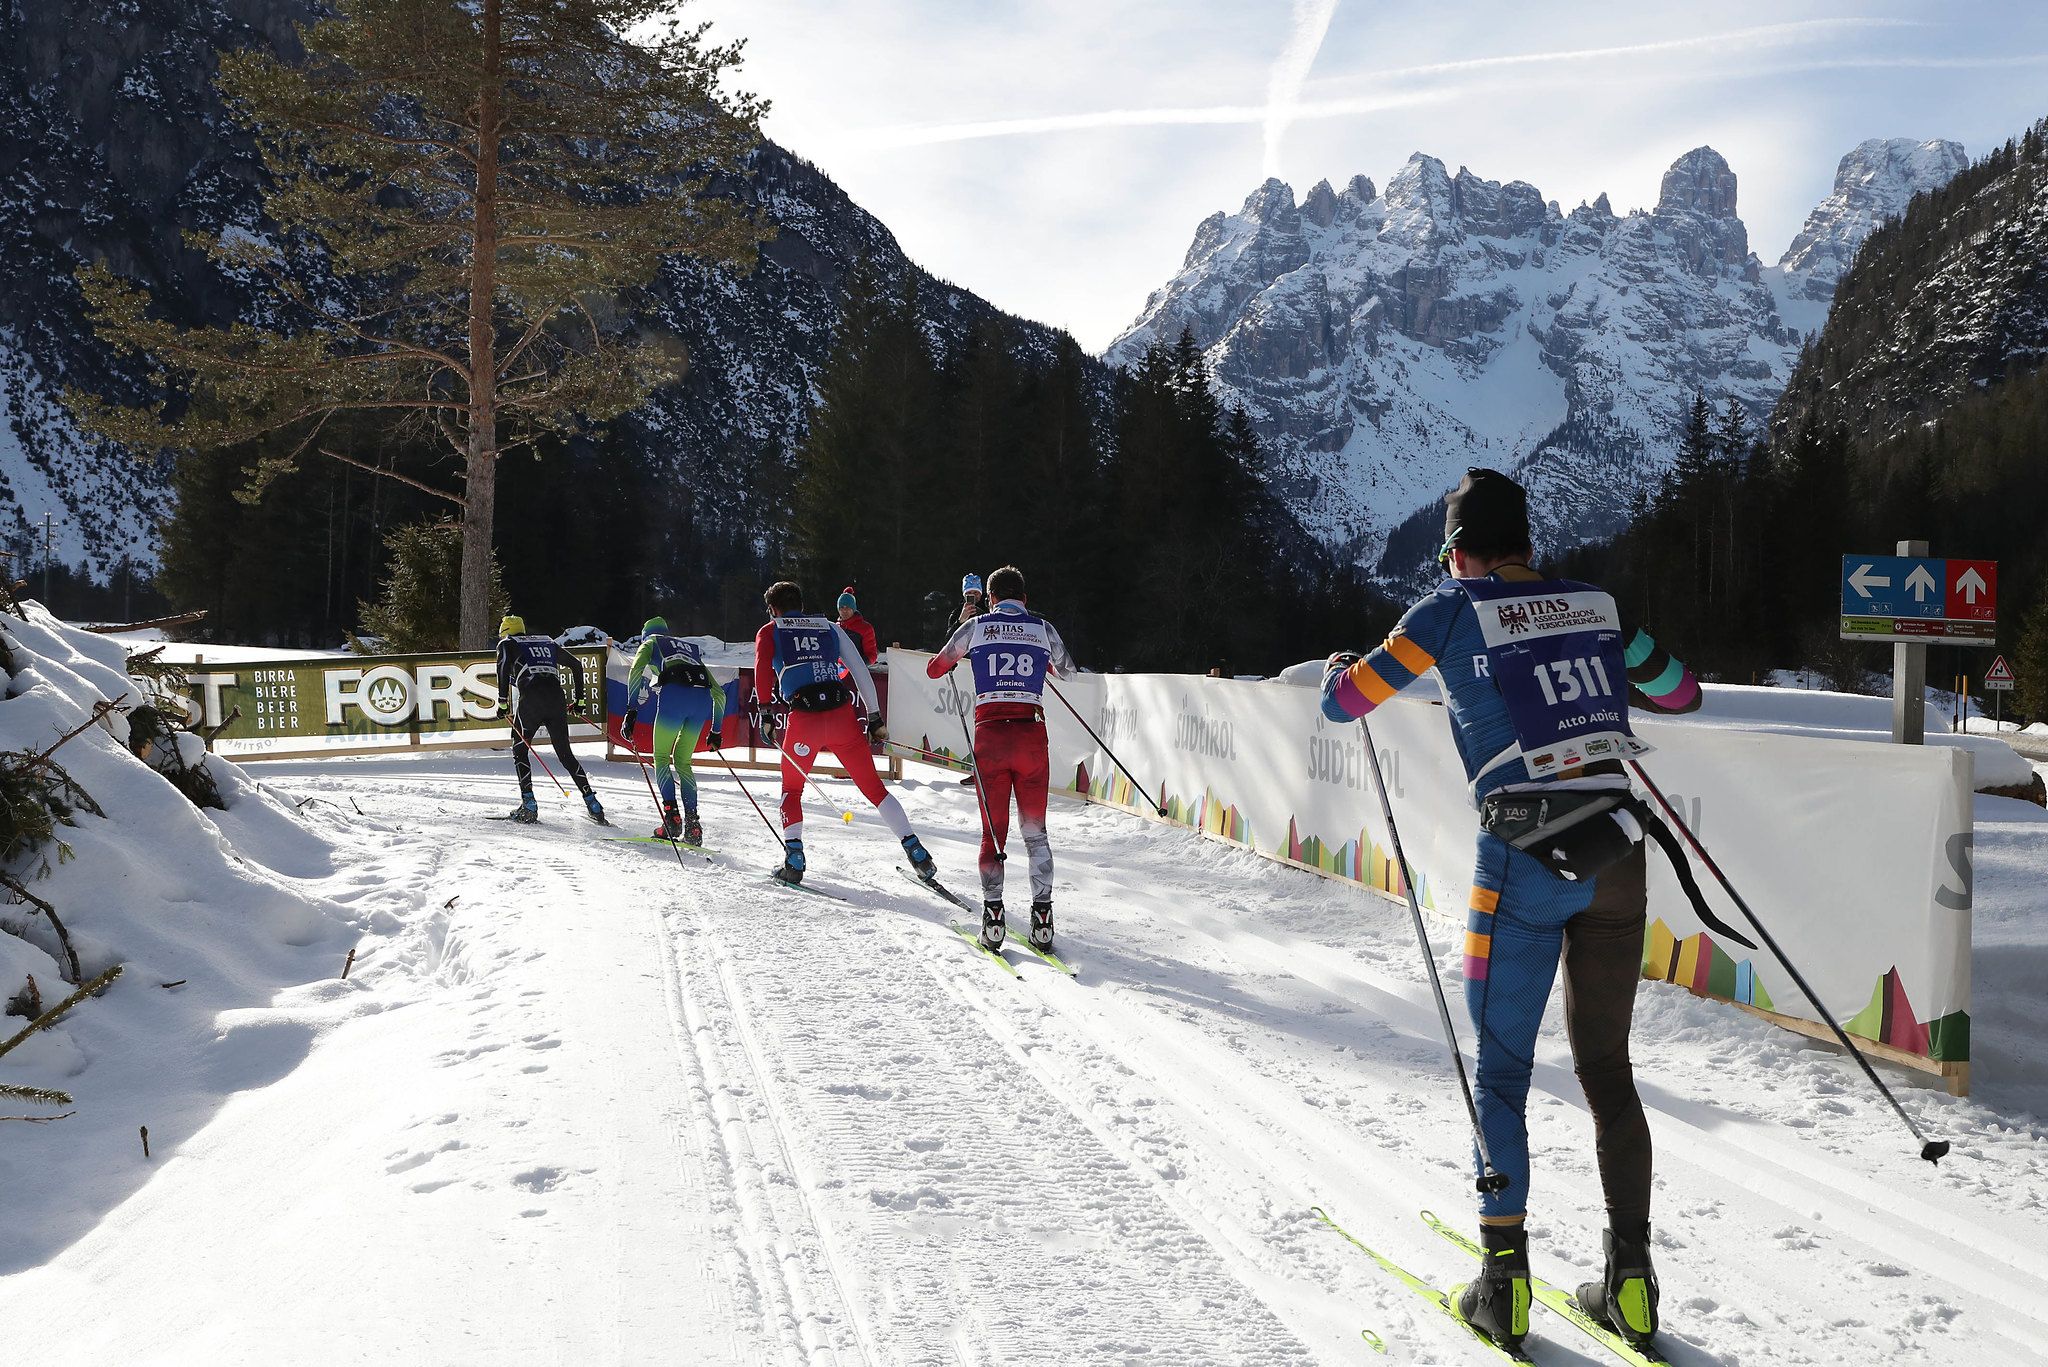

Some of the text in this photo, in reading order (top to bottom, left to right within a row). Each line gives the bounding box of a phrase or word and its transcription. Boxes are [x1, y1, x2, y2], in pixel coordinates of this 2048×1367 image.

[1526, 599, 1570, 616] ITAS
[1533, 608, 1596, 623] ASSICURAZIONI
[1535, 615, 1607, 631] VERSICHERUNGEN
[1002, 624, 1024, 633] ITAS
[793, 636, 820, 651] 145
[528, 647, 551, 658] 1319
[987, 652, 1034, 677] 128
[1472, 655, 1490, 678] R
[254, 669, 296, 683] BIRRA
[1533, 656, 1613, 706] 1311
[255, 682, 297, 698] BIÈRE
[322, 662, 520, 726] FORS
[256, 701, 298, 714] BEER
[257, 716, 299, 730] BIER
[1504, 807, 1528, 816] TAO
[1568, 1308, 1611, 1343] FISCHER
